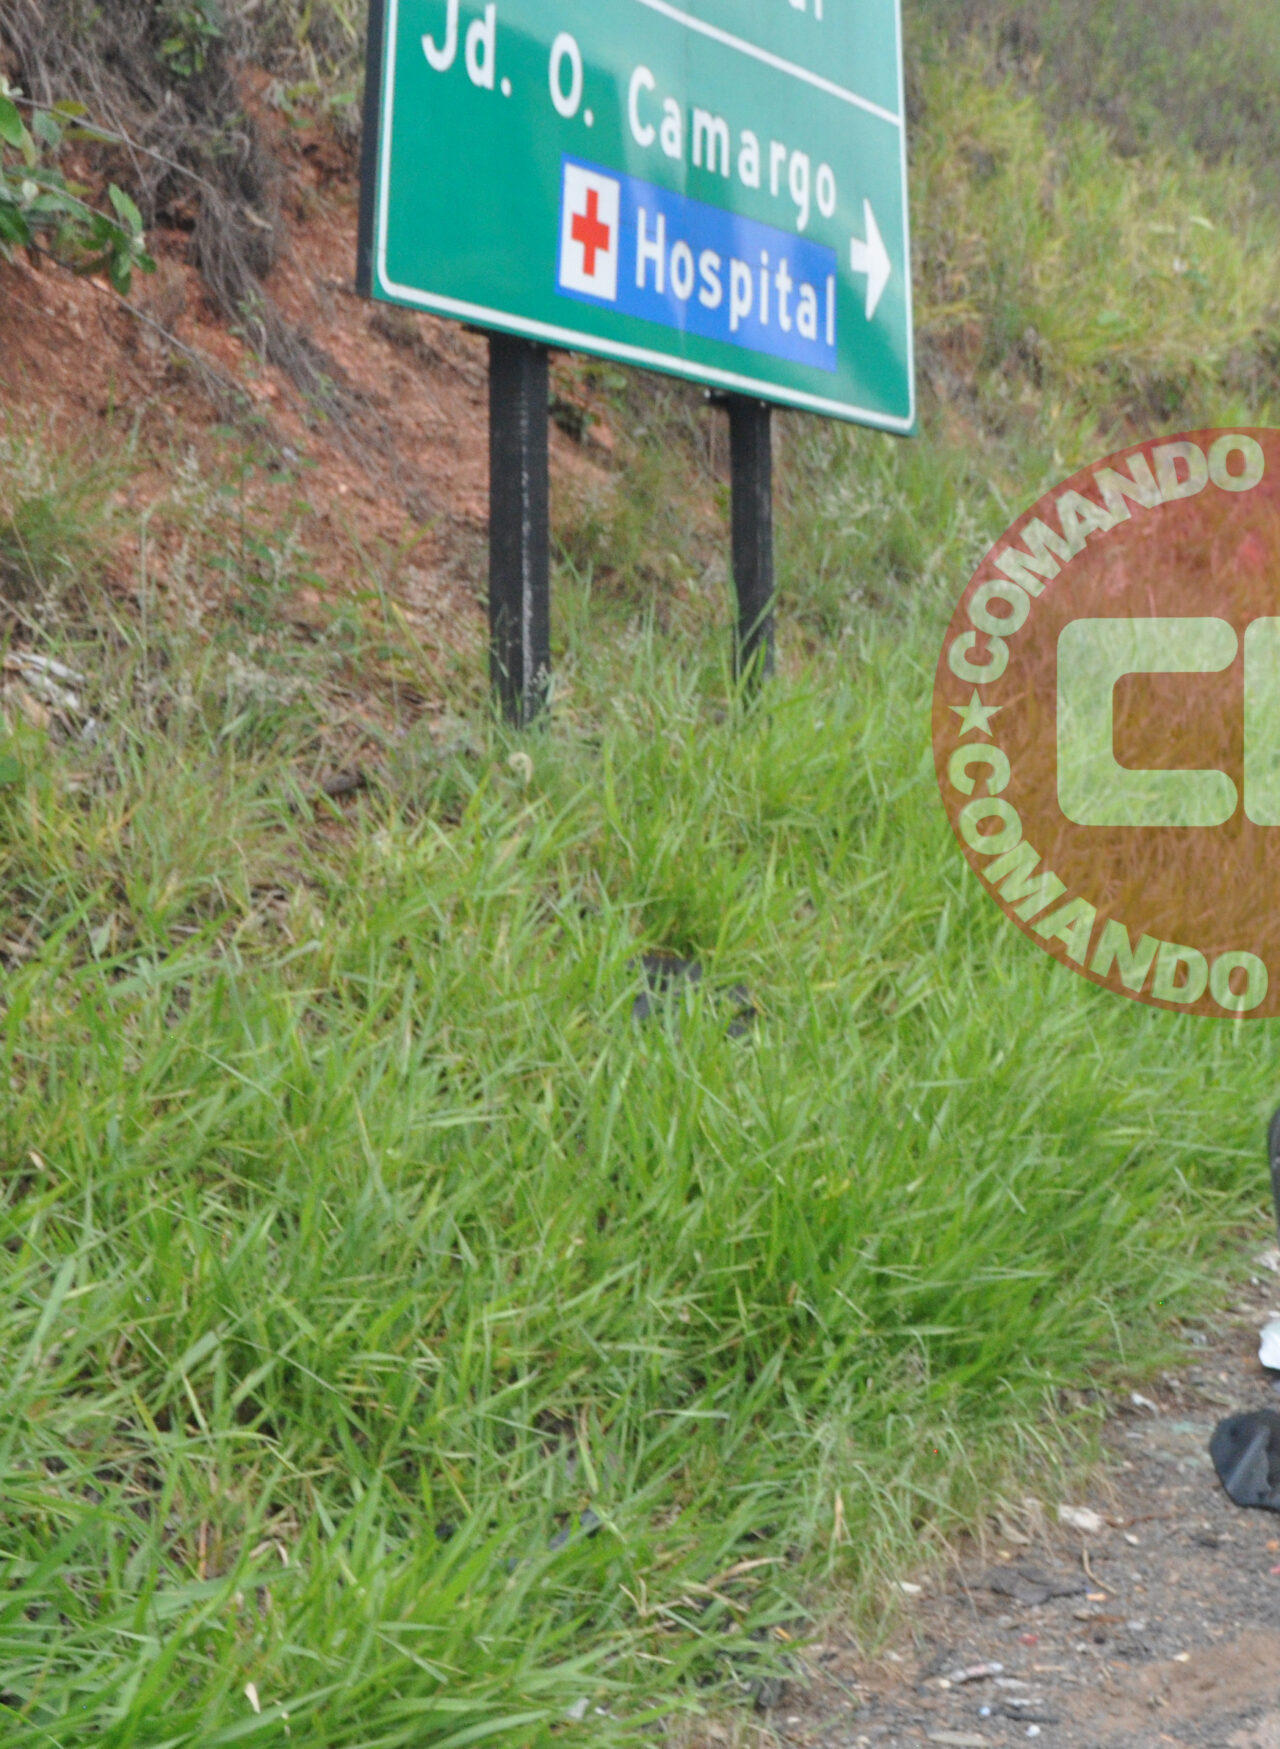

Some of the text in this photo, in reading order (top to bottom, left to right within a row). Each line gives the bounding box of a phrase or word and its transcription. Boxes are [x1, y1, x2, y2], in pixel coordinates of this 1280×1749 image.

[421, 0, 837, 232] Jd. O. Camargo
[635, 206, 836, 347] Hospital
